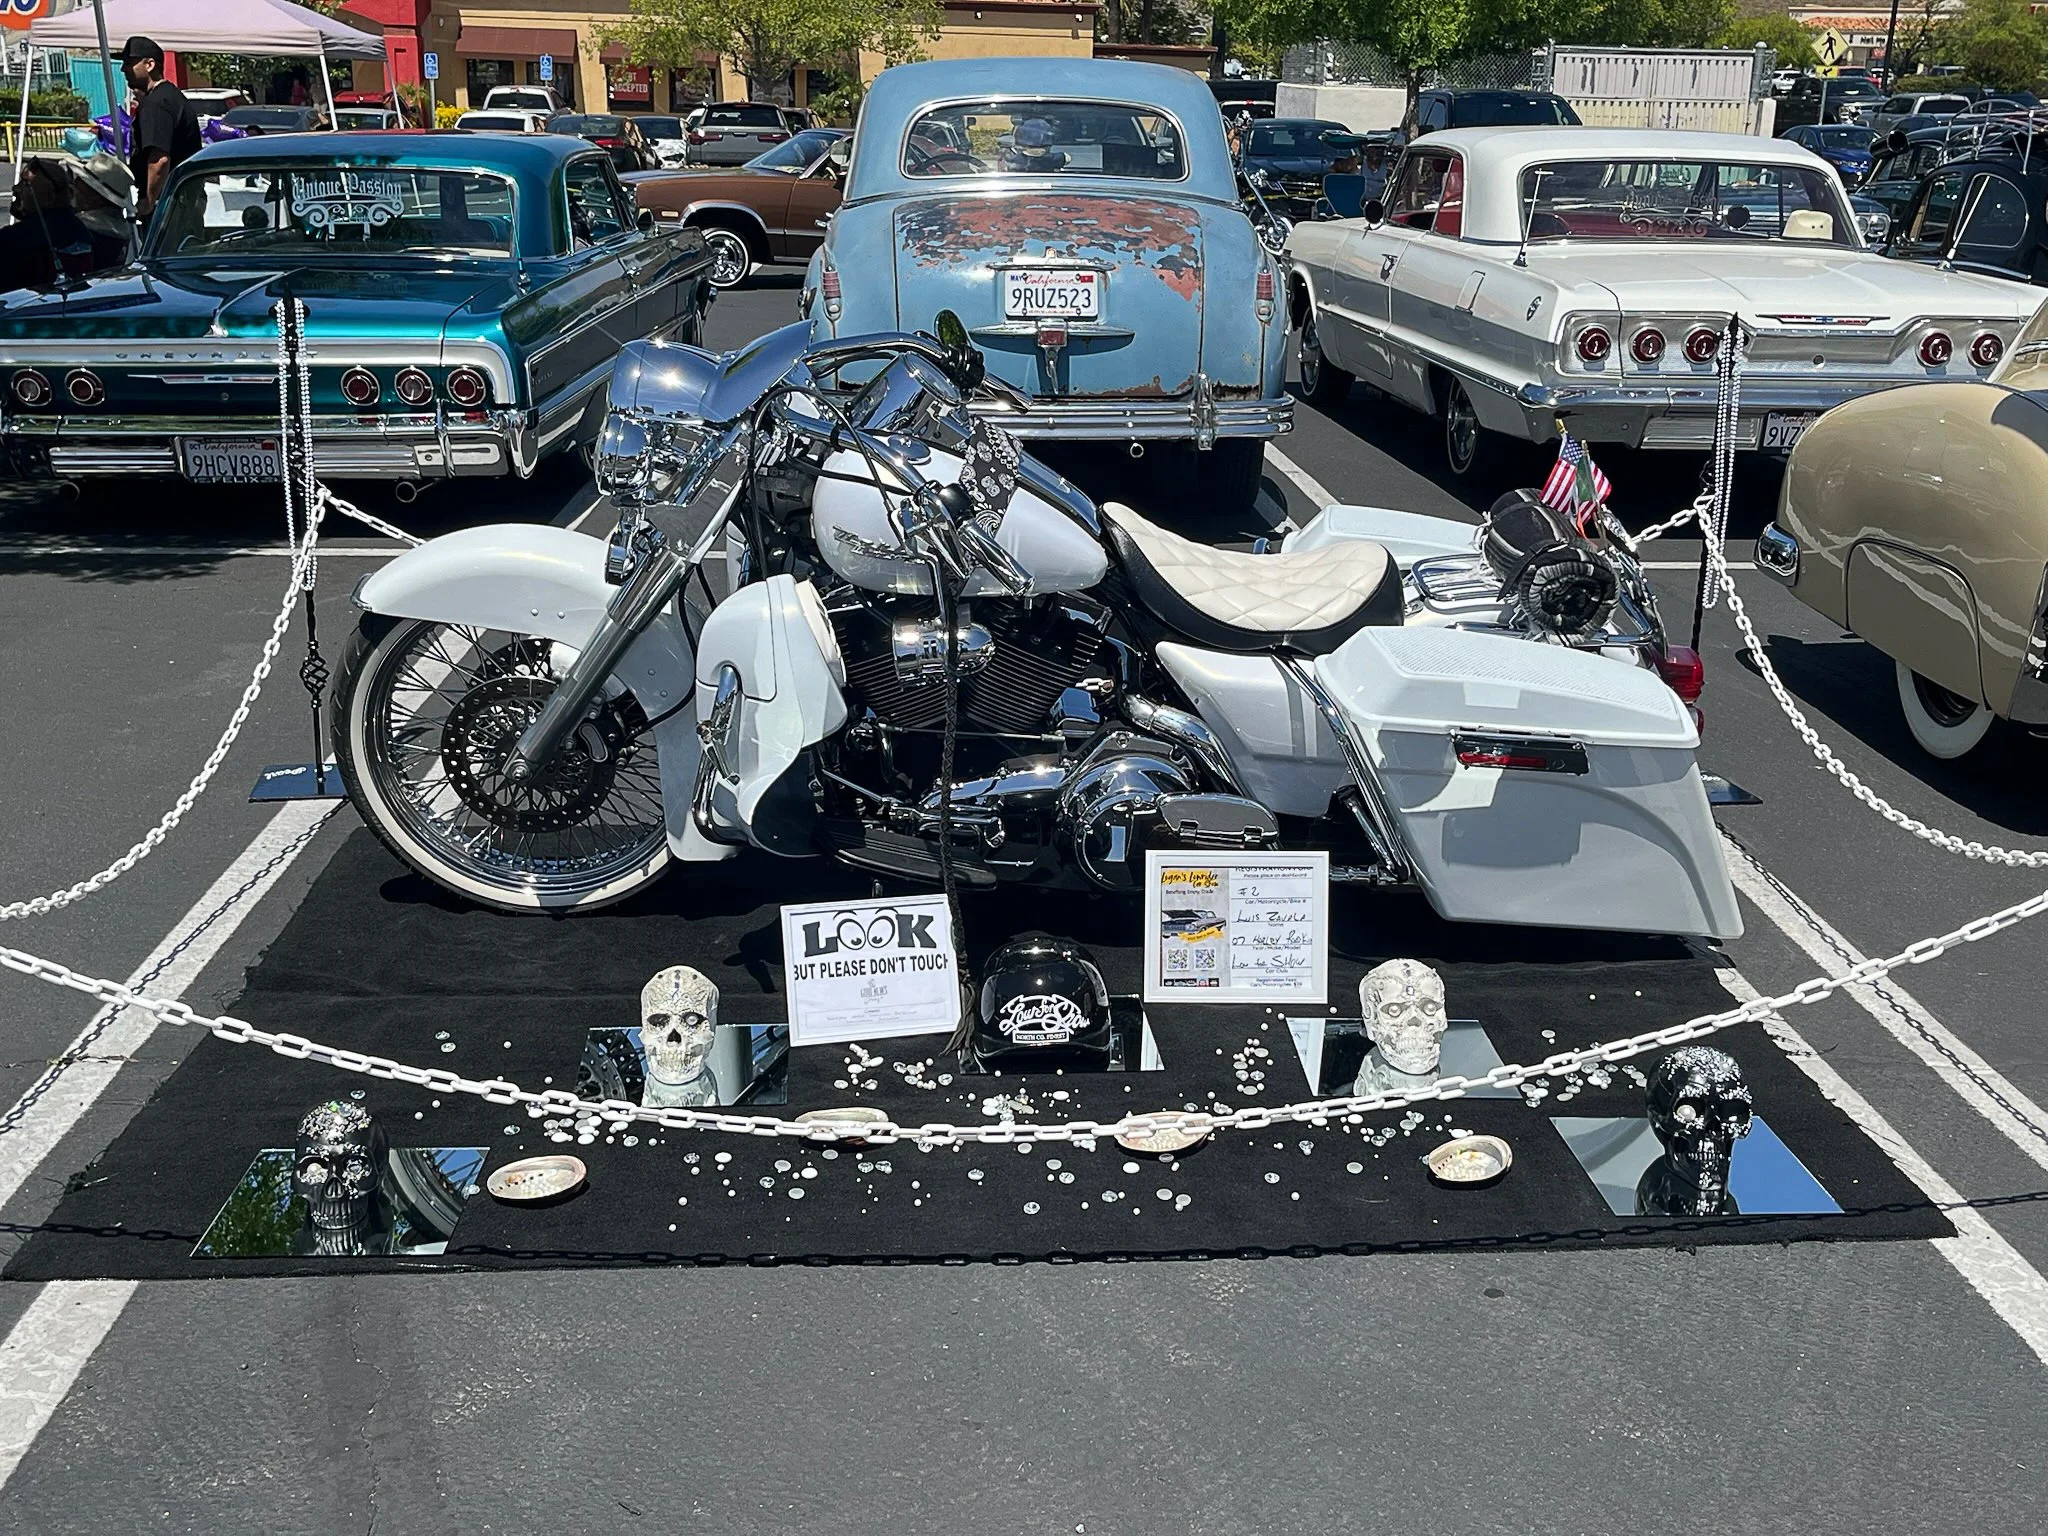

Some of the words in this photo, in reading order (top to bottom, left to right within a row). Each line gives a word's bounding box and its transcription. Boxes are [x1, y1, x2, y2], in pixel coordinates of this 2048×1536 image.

[292, 173, 340, 200] Unique
[345, 173, 402, 199] Passion
[1024, 274, 1075, 287] California
[1012, 288, 1091, 308] 9RUZ523
[1767, 426, 1806, 445] 9VZ
[204, 442, 257, 453] California
[193, 455, 275, 476] 9HCV888
[802, 912, 937, 958] LOOK
[794, 963, 816, 980] BUT
[820, 959, 867, 979] PLEASE
[870, 956, 906, 975] DON'T
